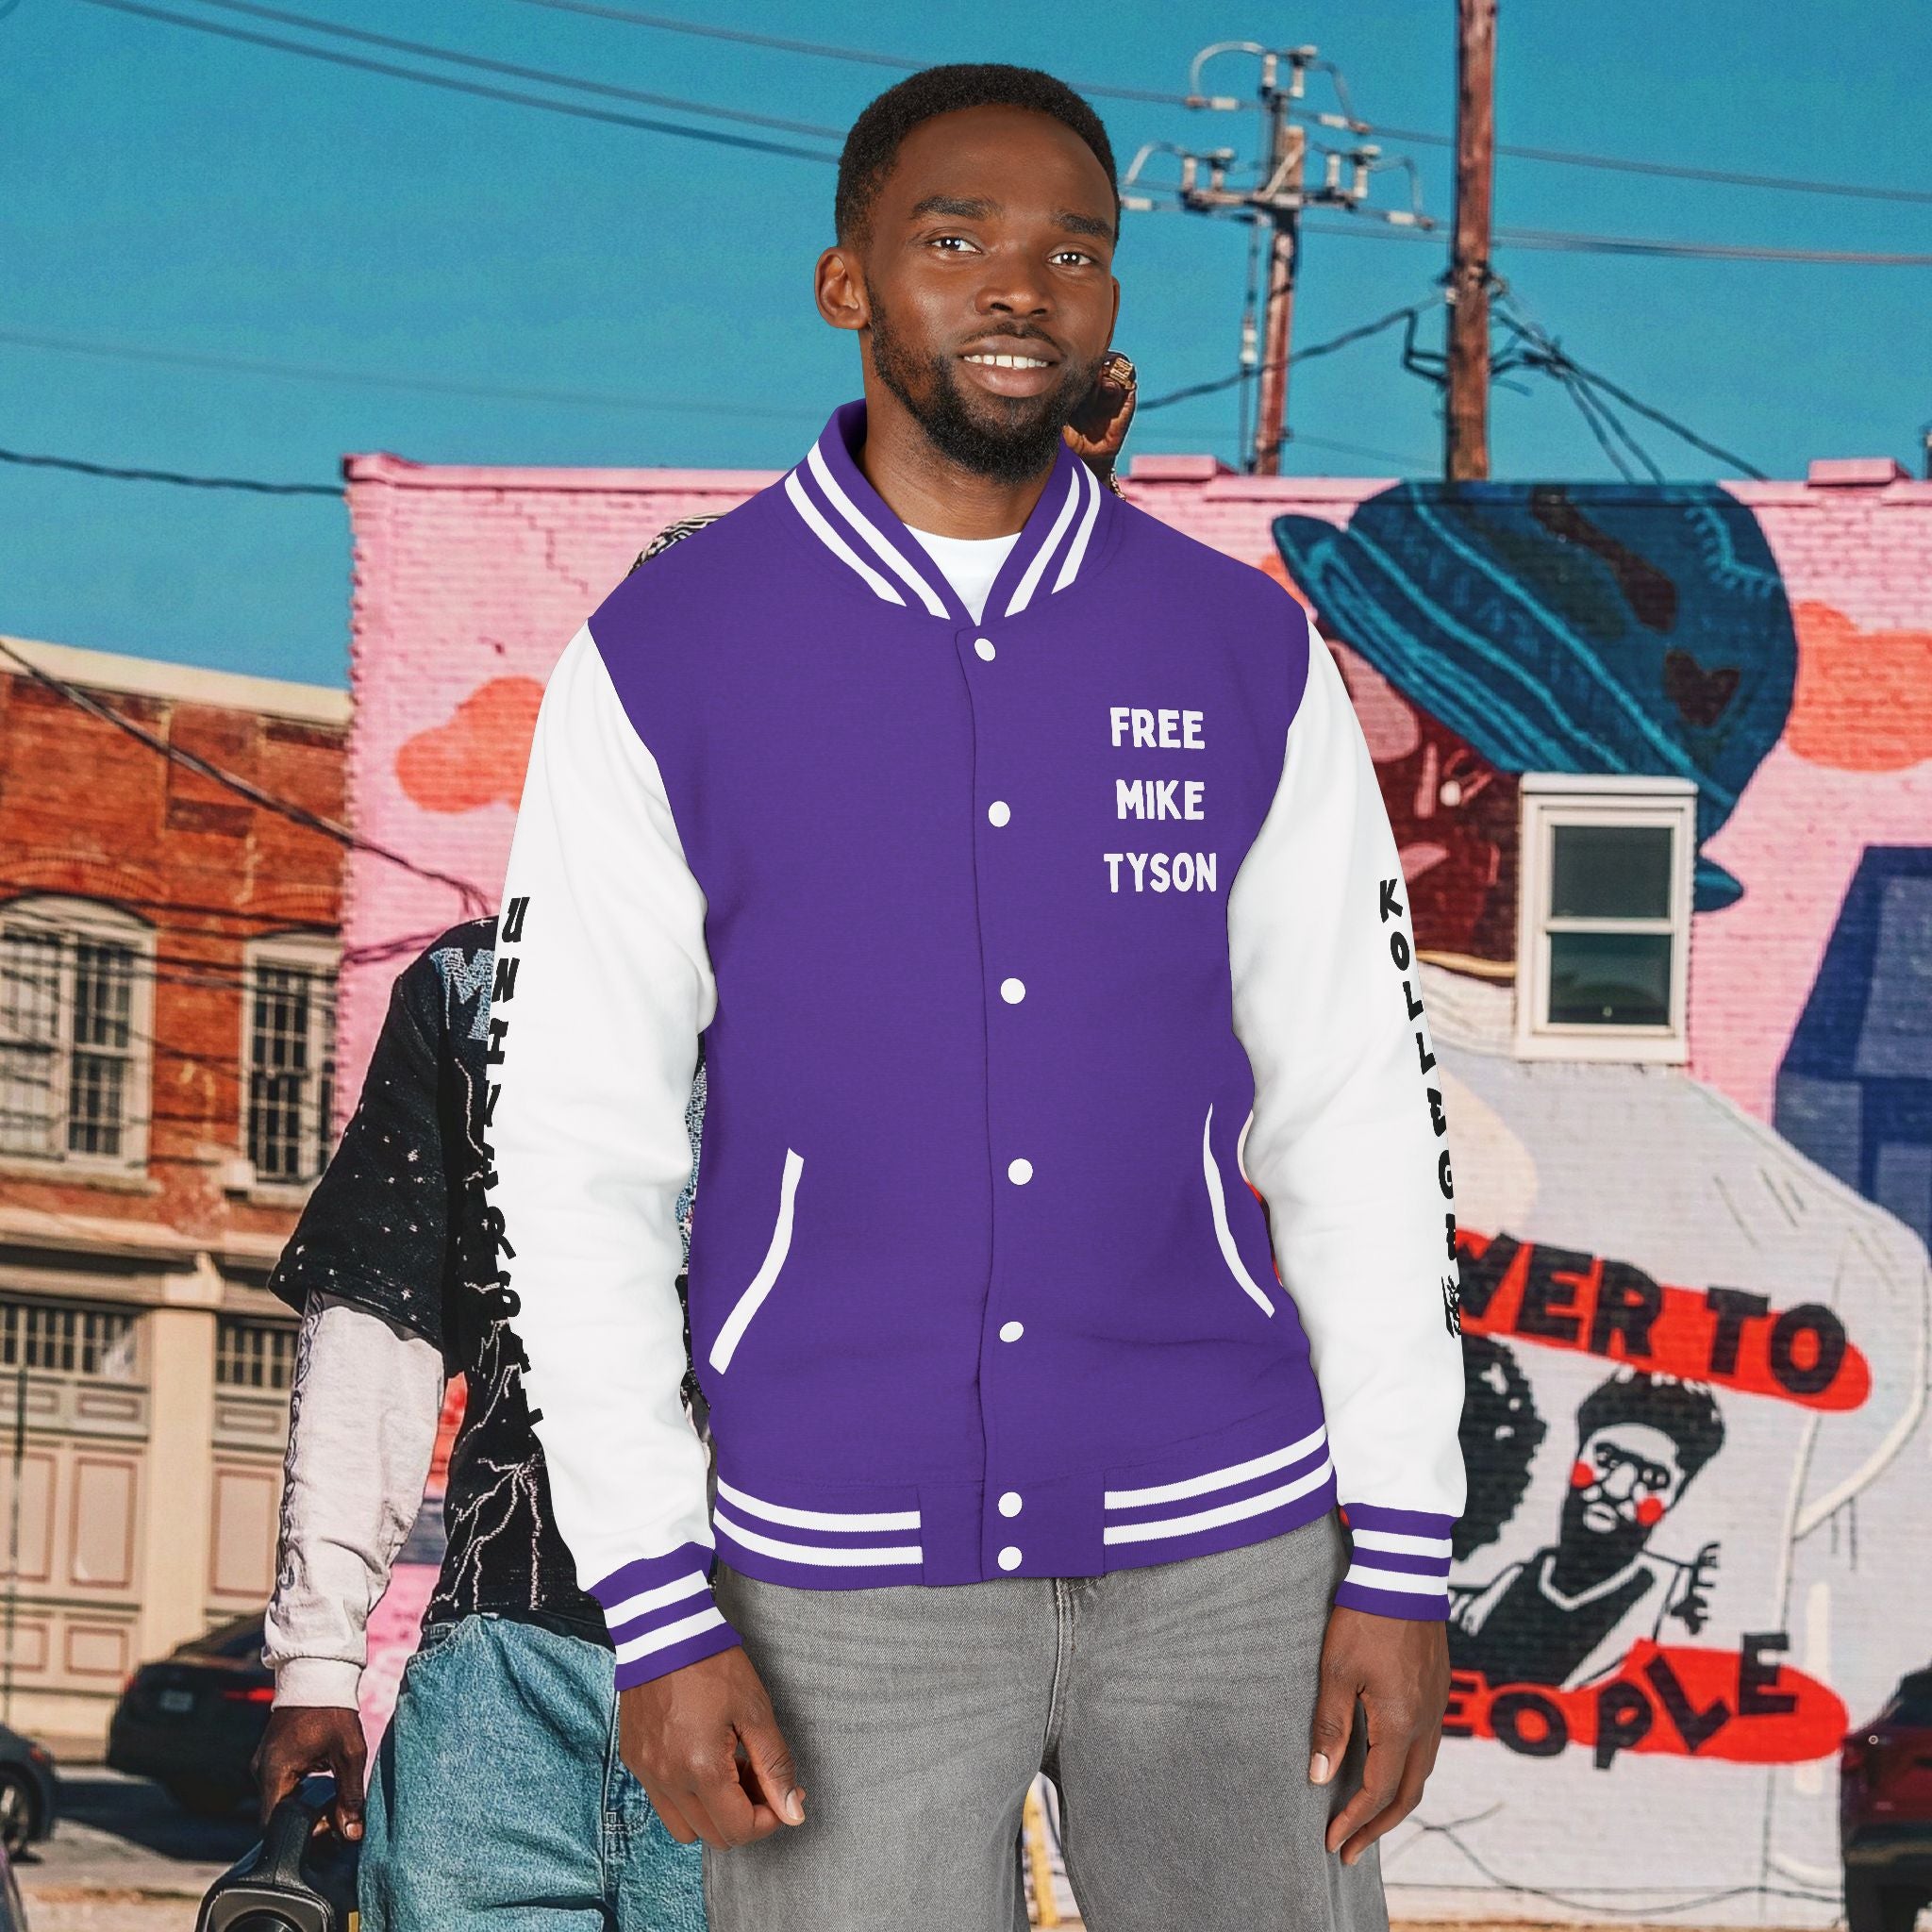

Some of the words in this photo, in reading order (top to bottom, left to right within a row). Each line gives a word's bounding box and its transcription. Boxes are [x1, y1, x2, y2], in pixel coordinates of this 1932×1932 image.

[1109, 707, 1206, 750] FREE
[1115, 778, 1206, 821] MIKE
[1103, 852, 1217, 893] TYSON
[1457, 1232, 1663, 1360] WER
[1706, 1285, 1847, 1395] TO
[1441, 1632, 1797, 1771] EOPLE
